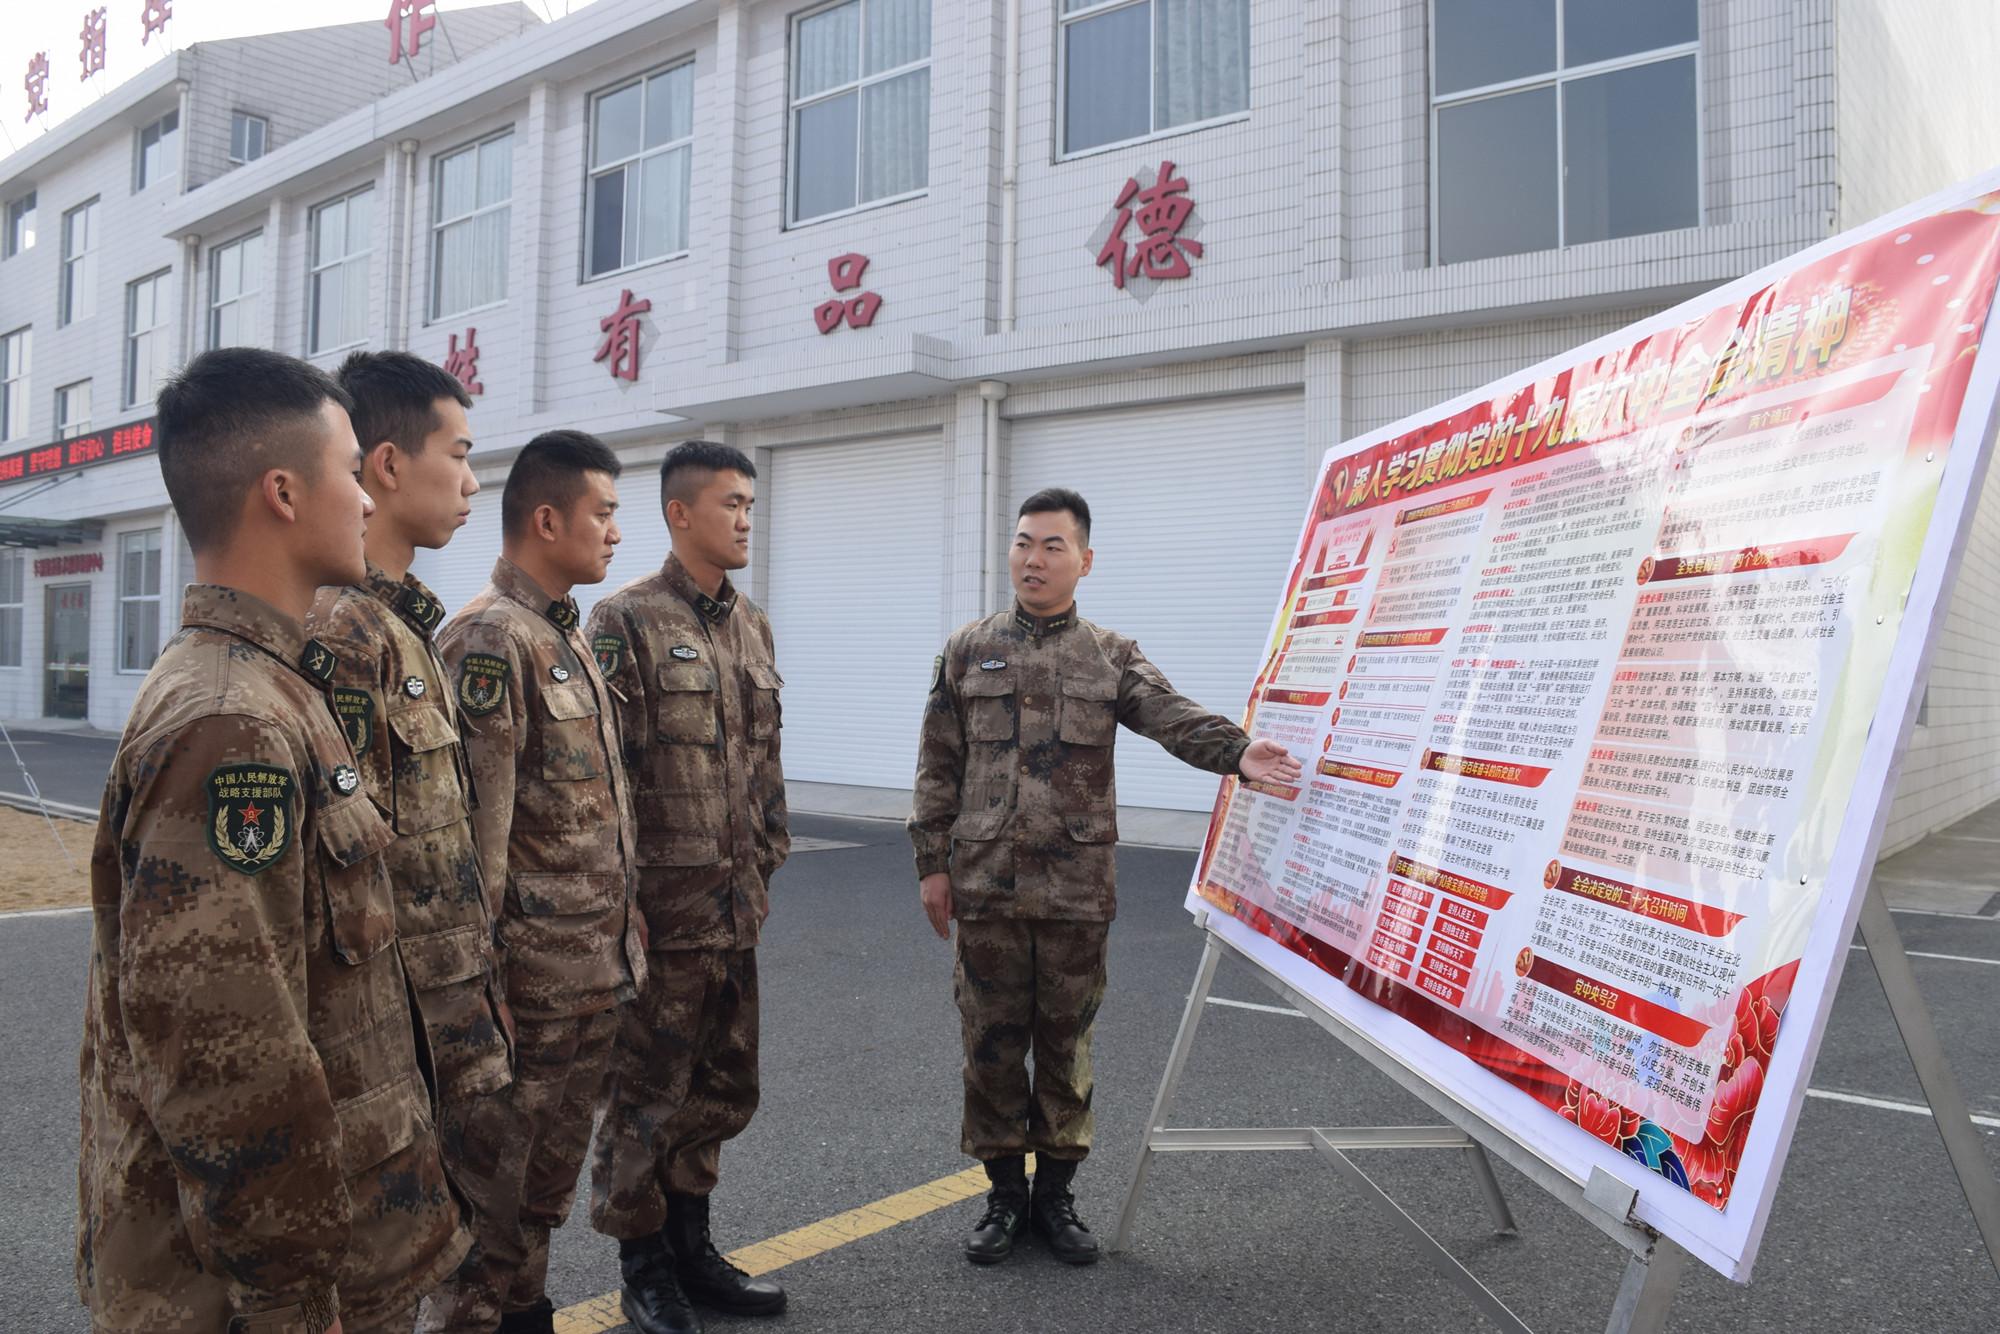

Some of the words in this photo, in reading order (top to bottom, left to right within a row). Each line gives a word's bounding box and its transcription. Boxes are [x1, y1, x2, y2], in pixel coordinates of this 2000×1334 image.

[25, 51, 49, 124] 党
[79, 6, 106, 83] 指
[593, 288, 652, 382] 有
[813, 252, 882, 335] 品
[1096, 160, 1204, 289] 德
[213, 771, 289, 787] 中国人民解放军
[218, 786, 283, 798] 战略支援部队
[1570, 874, 1689, 923] 全会决定党的二十大召开时间
[1446, 902, 1477, 924] 坚持人民至上
[1440, 921, 1470, 943] 坚持独立自主
[1428, 957, 1458, 981] 坚持敢于斗争
[1572, 977, 1619, 1011] 党中央号召
